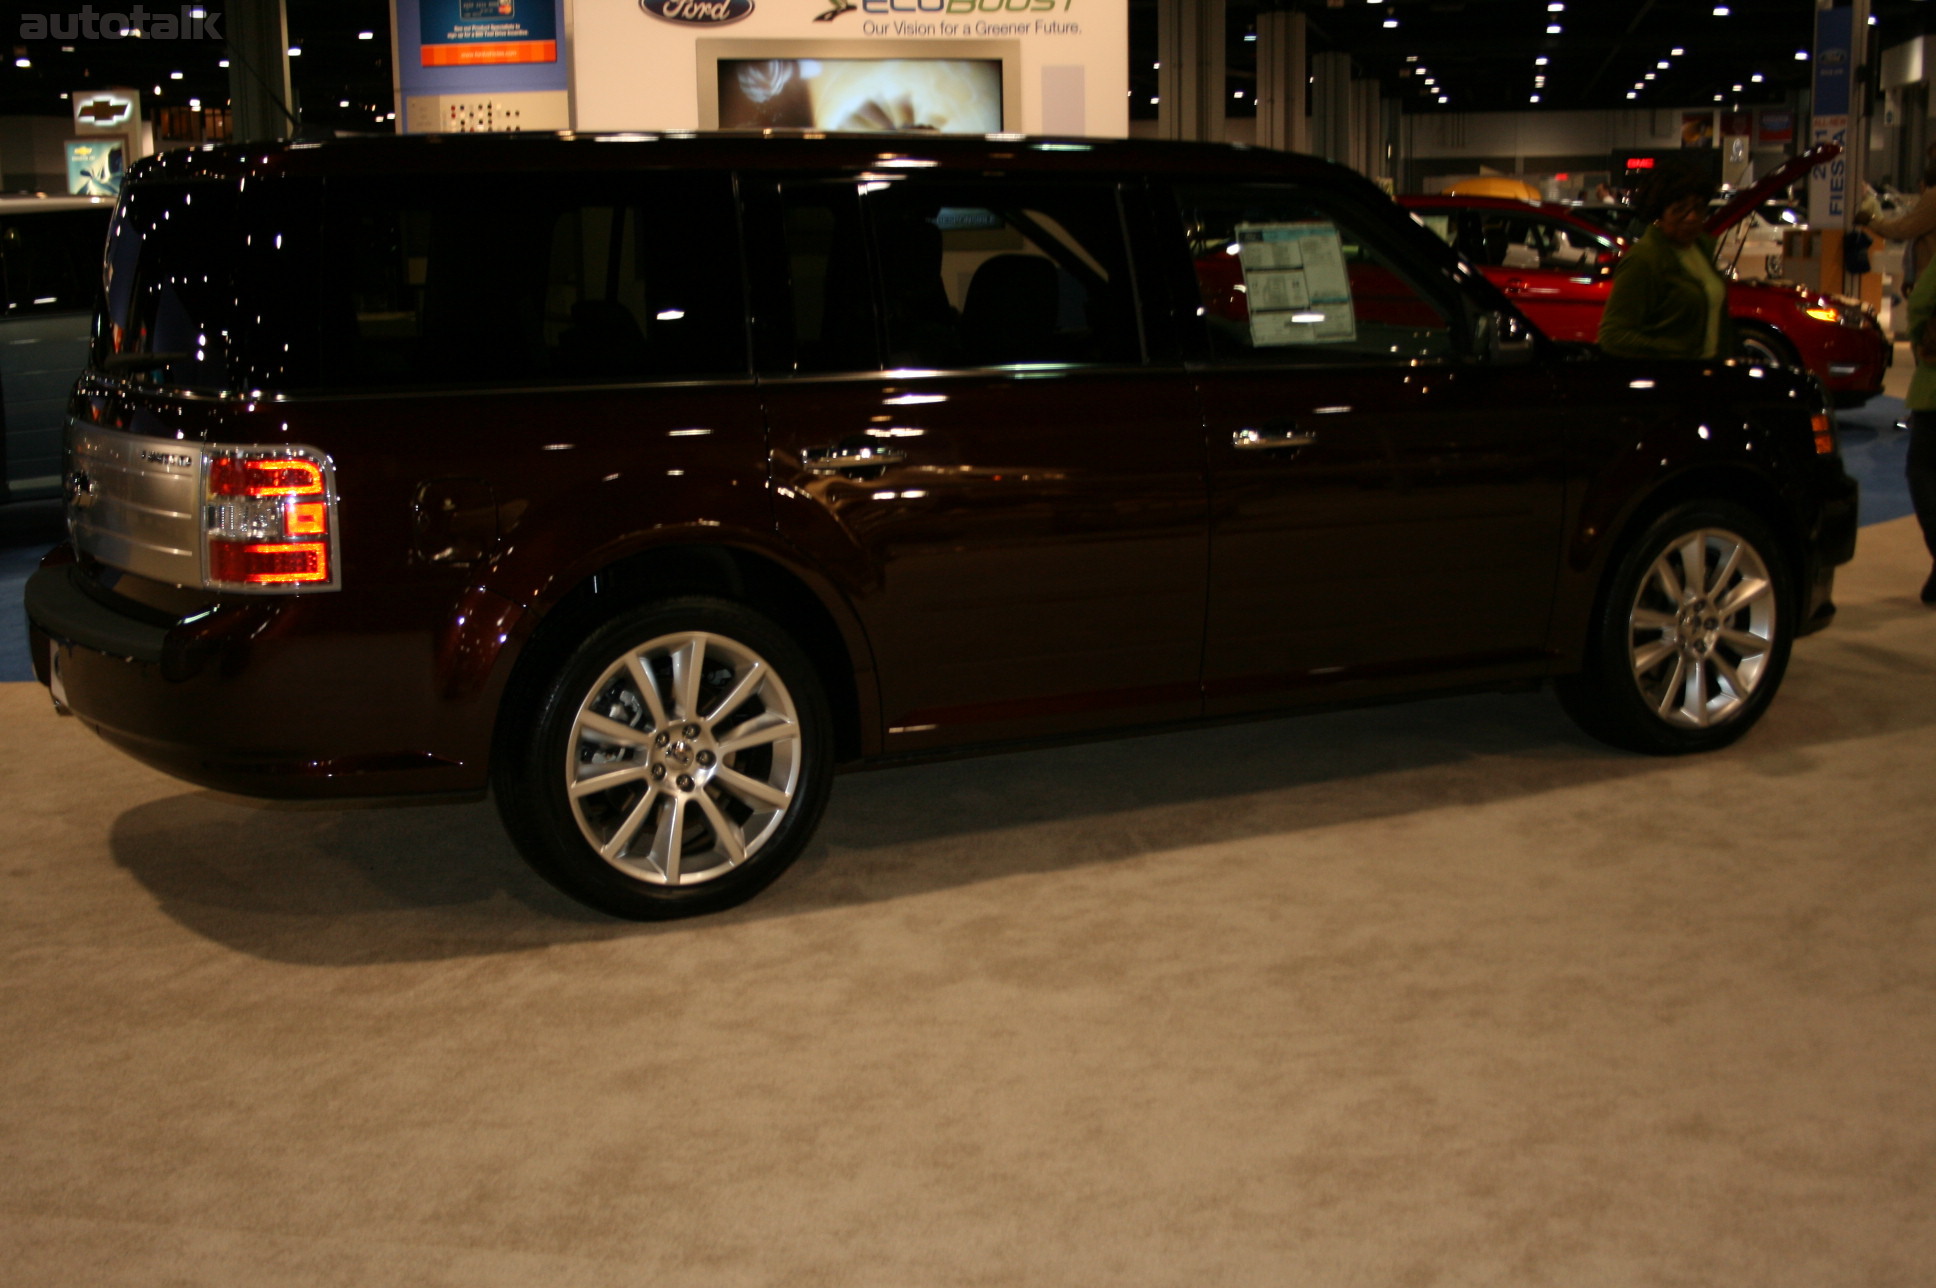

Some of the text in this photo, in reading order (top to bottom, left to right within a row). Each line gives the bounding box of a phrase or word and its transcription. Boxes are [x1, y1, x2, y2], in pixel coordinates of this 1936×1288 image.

[863, 19, 1082, 36] Our Vision for a Greener Future.
[1829, 129, 1846, 216] FIESA
